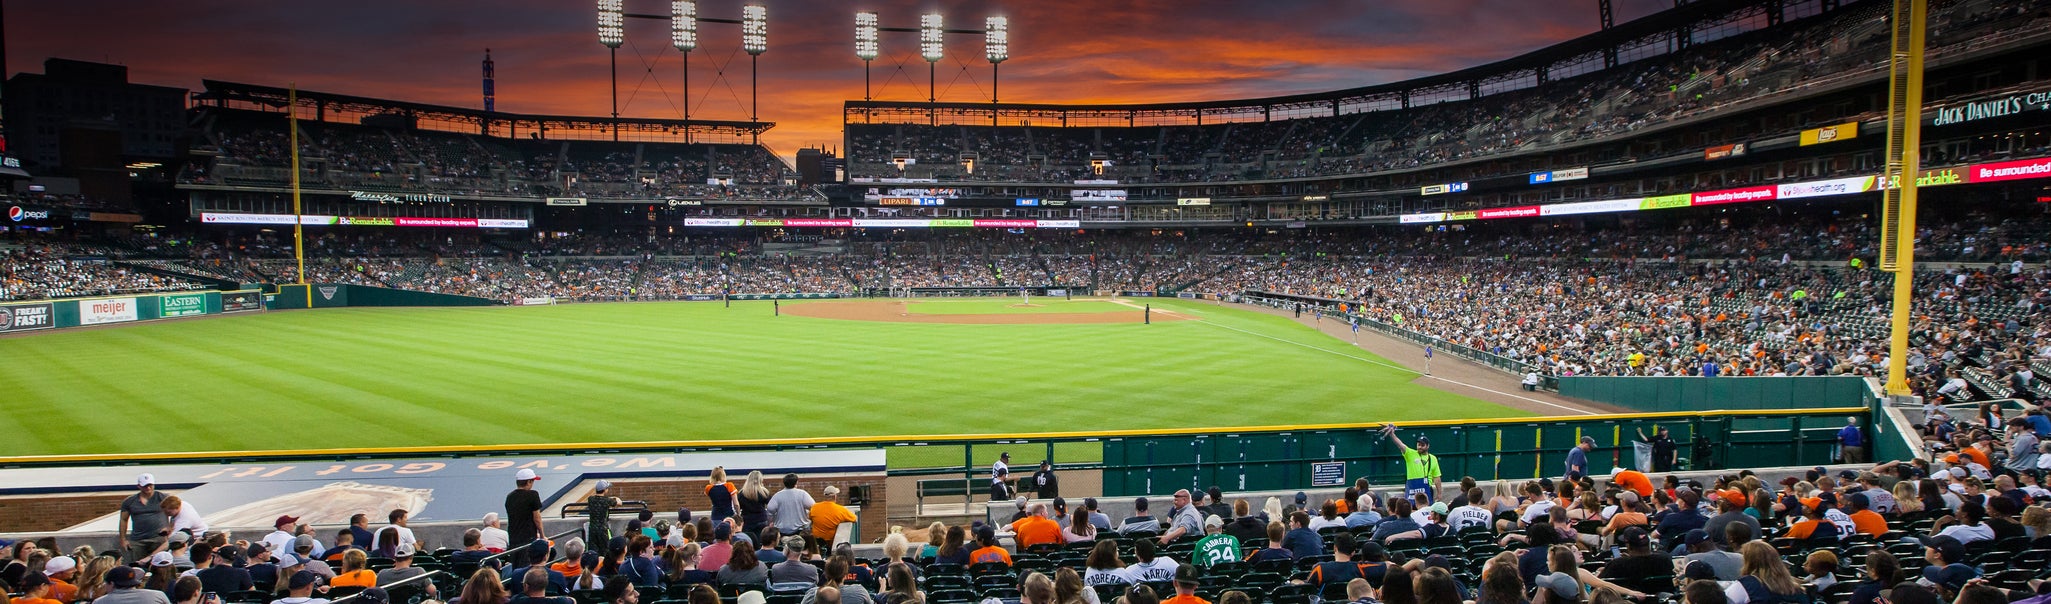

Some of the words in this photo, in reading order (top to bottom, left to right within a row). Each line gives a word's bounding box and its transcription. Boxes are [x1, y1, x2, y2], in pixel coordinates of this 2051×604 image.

[1934, 108, 1964, 126] JACK
[1967, 96, 2021, 120] DANIEL'S
[1980, 168, 1993, 178] Be
[1994, 162, 2051, 176] surrounded
[405, 194, 427, 202] TIGER
[433, 195, 450, 203] CLUB
[23, 209, 48, 220] pepsi
[93, 299, 126, 315] meijer
[164, 296, 201, 307] EASTERN
[15, 306, 48, 316] FREAKY
[14, 314, 48, 327] FAST!
[315, 462, 447, 475] Got
[1462, 510, 1488, 521] FIELDER
[1203, 537, 1233, 552] CABRERA
[1208, 546, 1236, 568] 24
[1087, 573, 1122, 588] CABRERA
